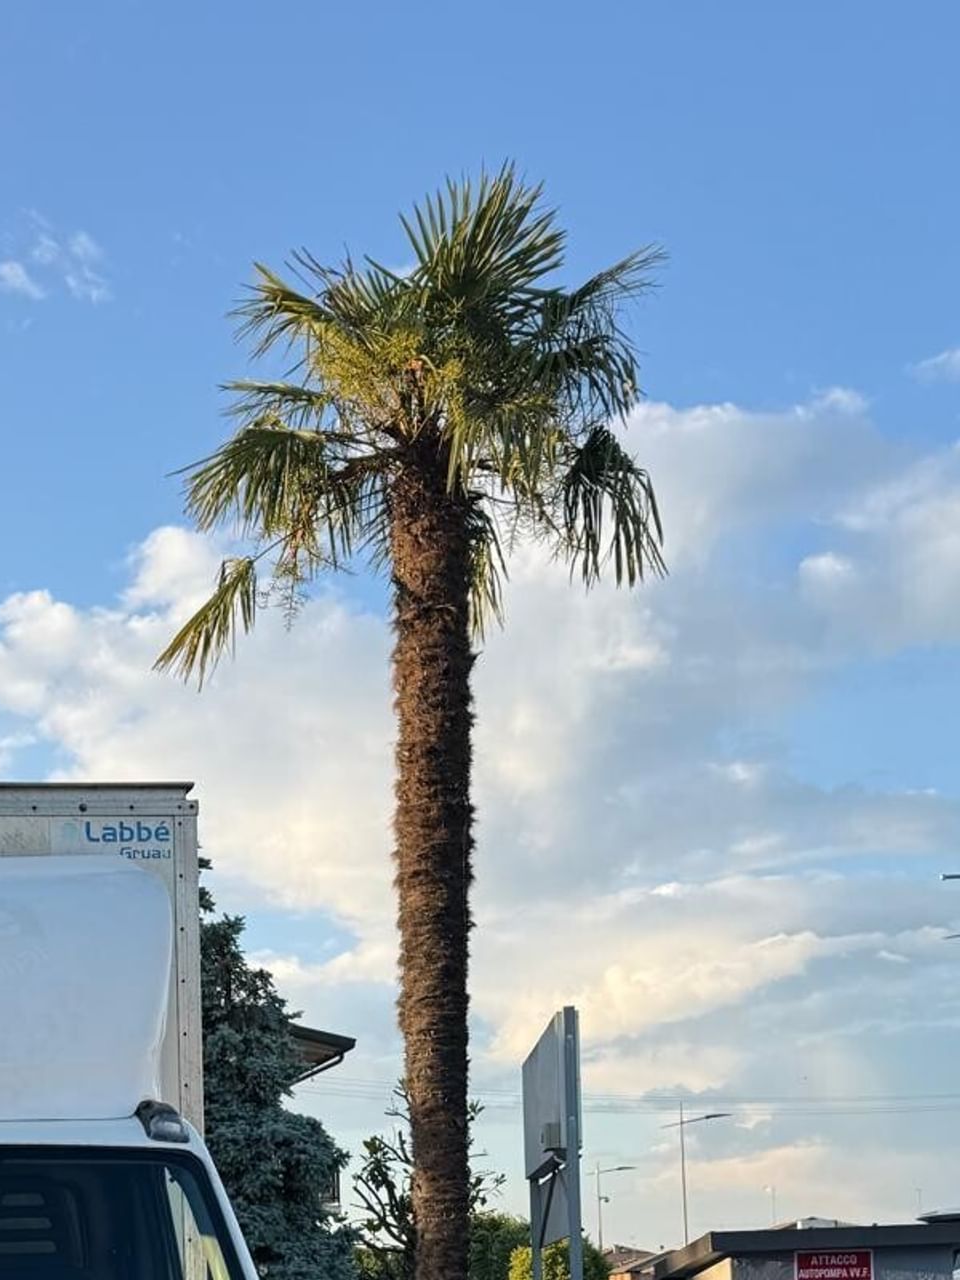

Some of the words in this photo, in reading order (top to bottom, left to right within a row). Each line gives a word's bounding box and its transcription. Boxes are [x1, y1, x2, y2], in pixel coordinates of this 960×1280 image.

[85, 820, 170, 842] Labbé
[810, 1254, 857, 1265] ATTACCO
[798, 1268, 847, 1279] AUTOPOMPA
